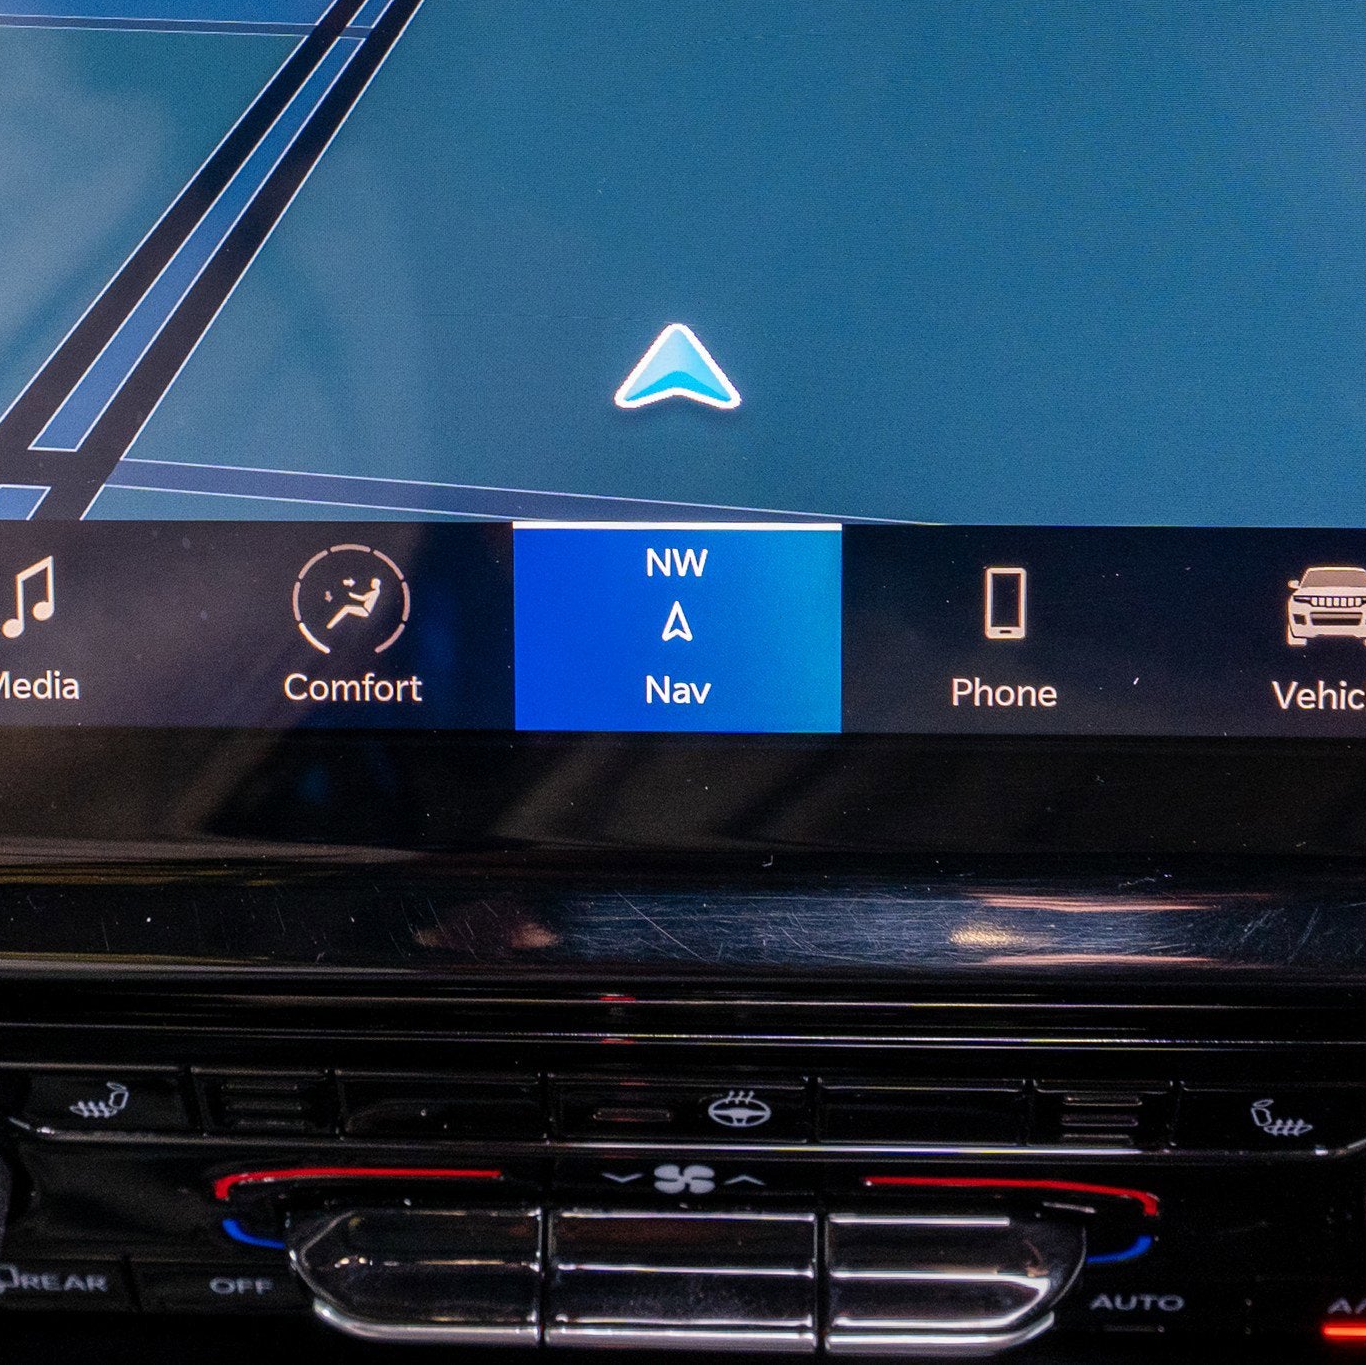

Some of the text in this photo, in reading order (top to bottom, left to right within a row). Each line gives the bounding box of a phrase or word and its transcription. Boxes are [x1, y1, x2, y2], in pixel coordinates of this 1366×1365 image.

[646, 547, 709, 578] NW
[284, 672, 423, 702] Comfort
[645, 674, 712, 705] Nav
[952, 676, 1058, 707] Phone
[19, 1273, 106, 1291] REAR
[209, 1278, 270, 1294] OFF
[1091, 1294, 1184, 1311] AUTO
